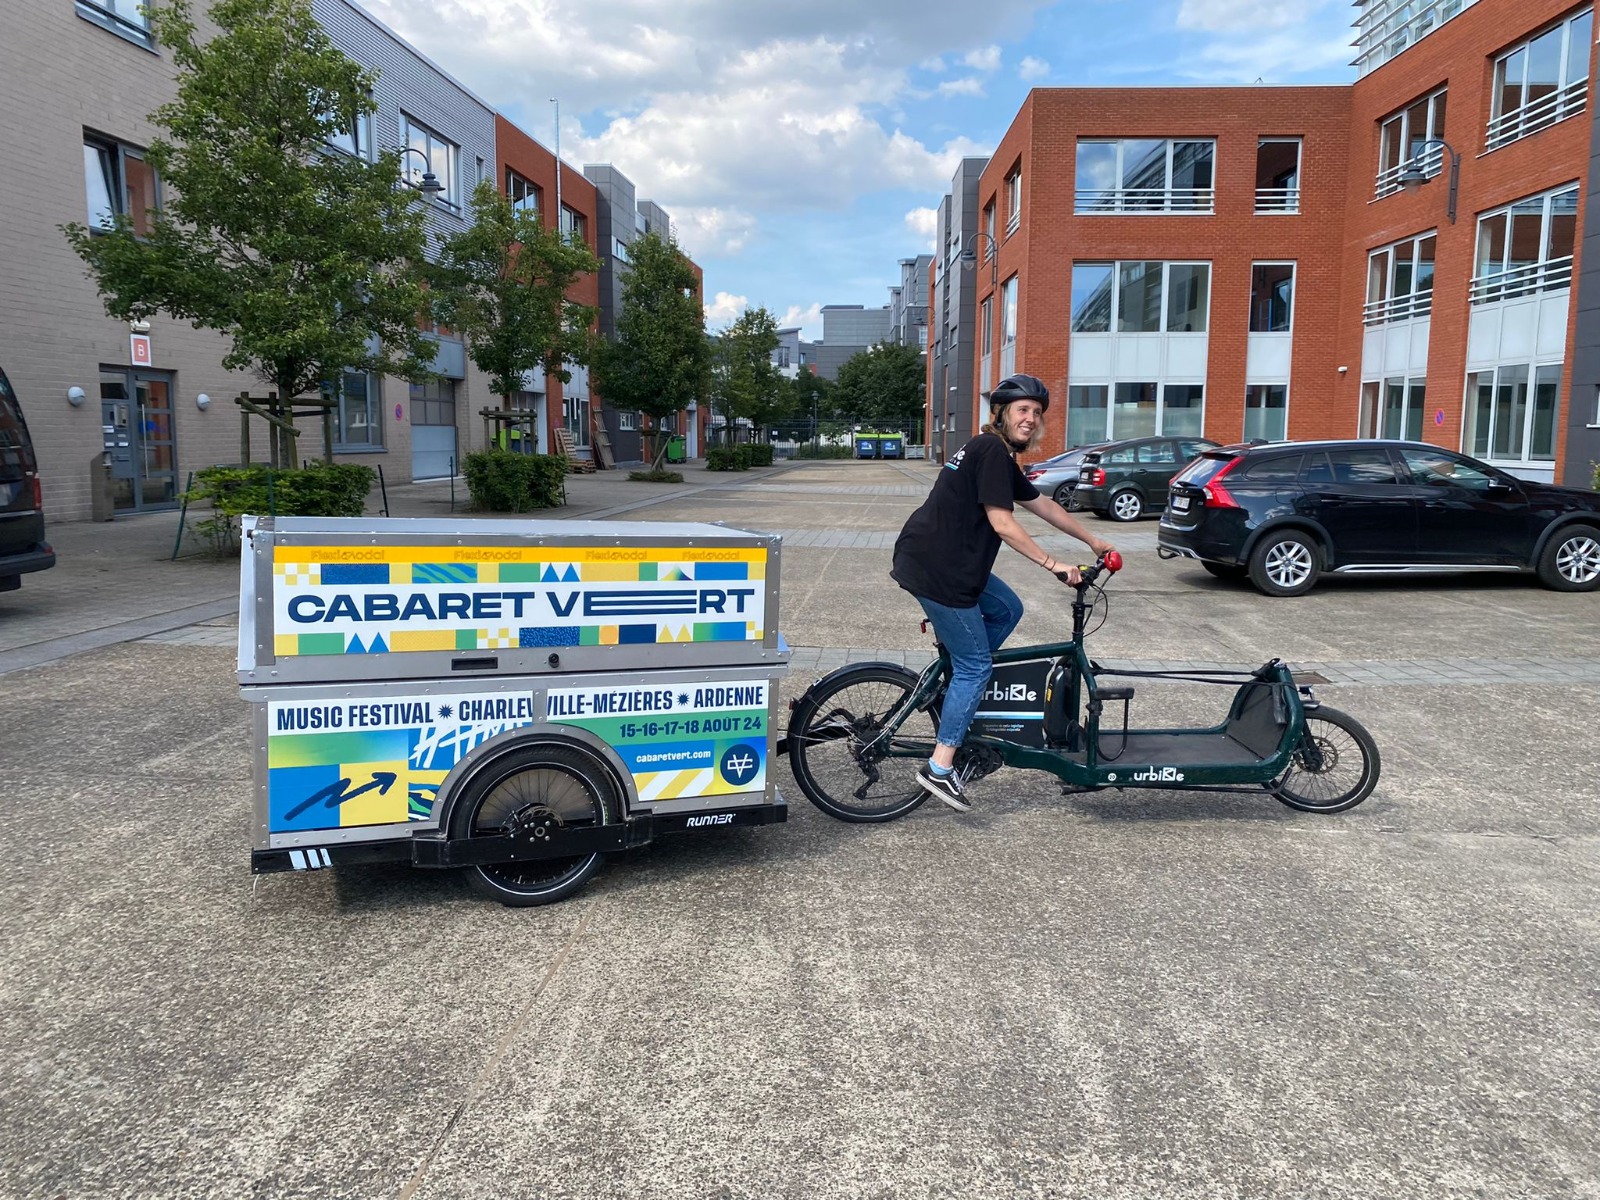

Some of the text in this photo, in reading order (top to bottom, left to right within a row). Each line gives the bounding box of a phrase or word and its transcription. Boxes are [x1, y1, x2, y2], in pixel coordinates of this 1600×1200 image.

[138, 344, 145, 357] B
[287, 592, 536, 624] CABARET
[277, 706, 343, 731] MUSIC
[349, 702, 434, 728] FESTIVAL
[693, 685, 763, 709] ARDENNE
[619, 716, 762, 738] 15-16-17-18 AOÛT 24
[636, 750, 712, 763] cabaretvert.com
[686, 814, 734, 828] RUNNER
